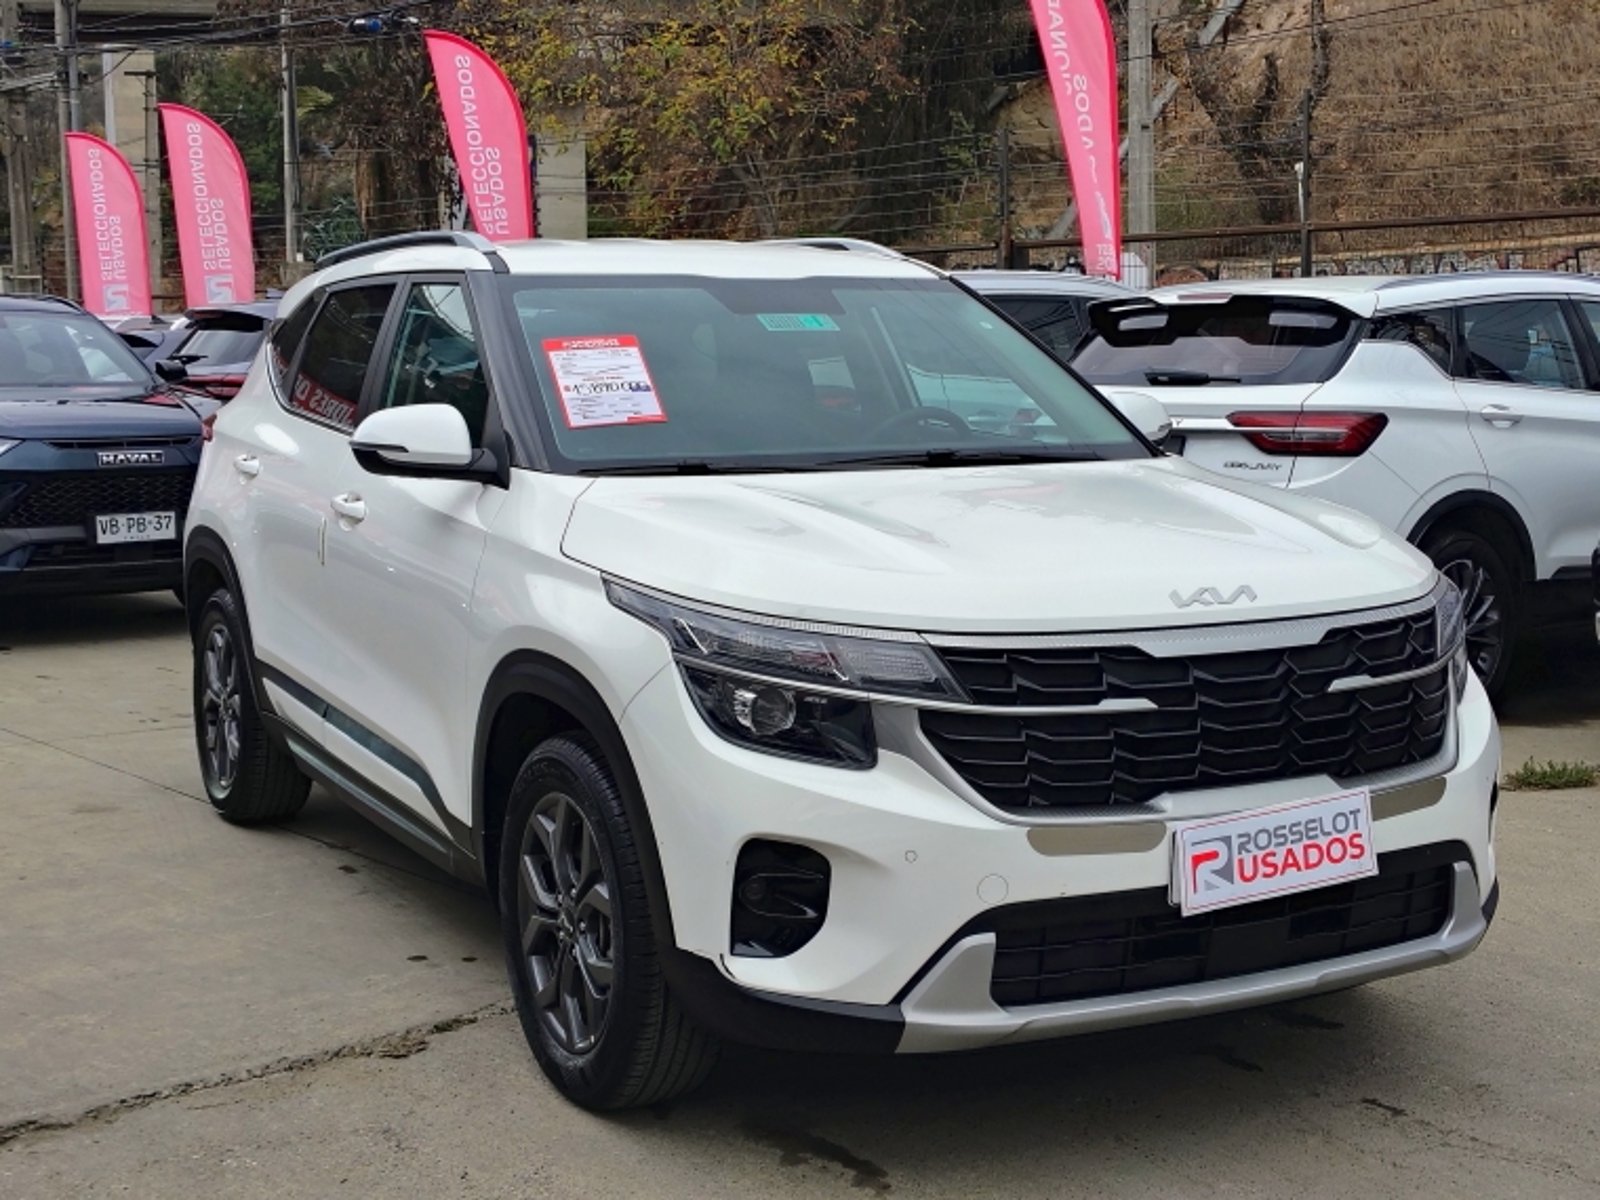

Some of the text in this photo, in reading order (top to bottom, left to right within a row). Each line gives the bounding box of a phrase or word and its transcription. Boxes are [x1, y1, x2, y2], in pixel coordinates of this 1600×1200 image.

[102, 453, 162, 464] HAVAL
[1168, 584, 1258, 608] KIA
[1237, 808, 1361, 855] ROSSELOT
[1236, 833, 1366, 884] USADOS
